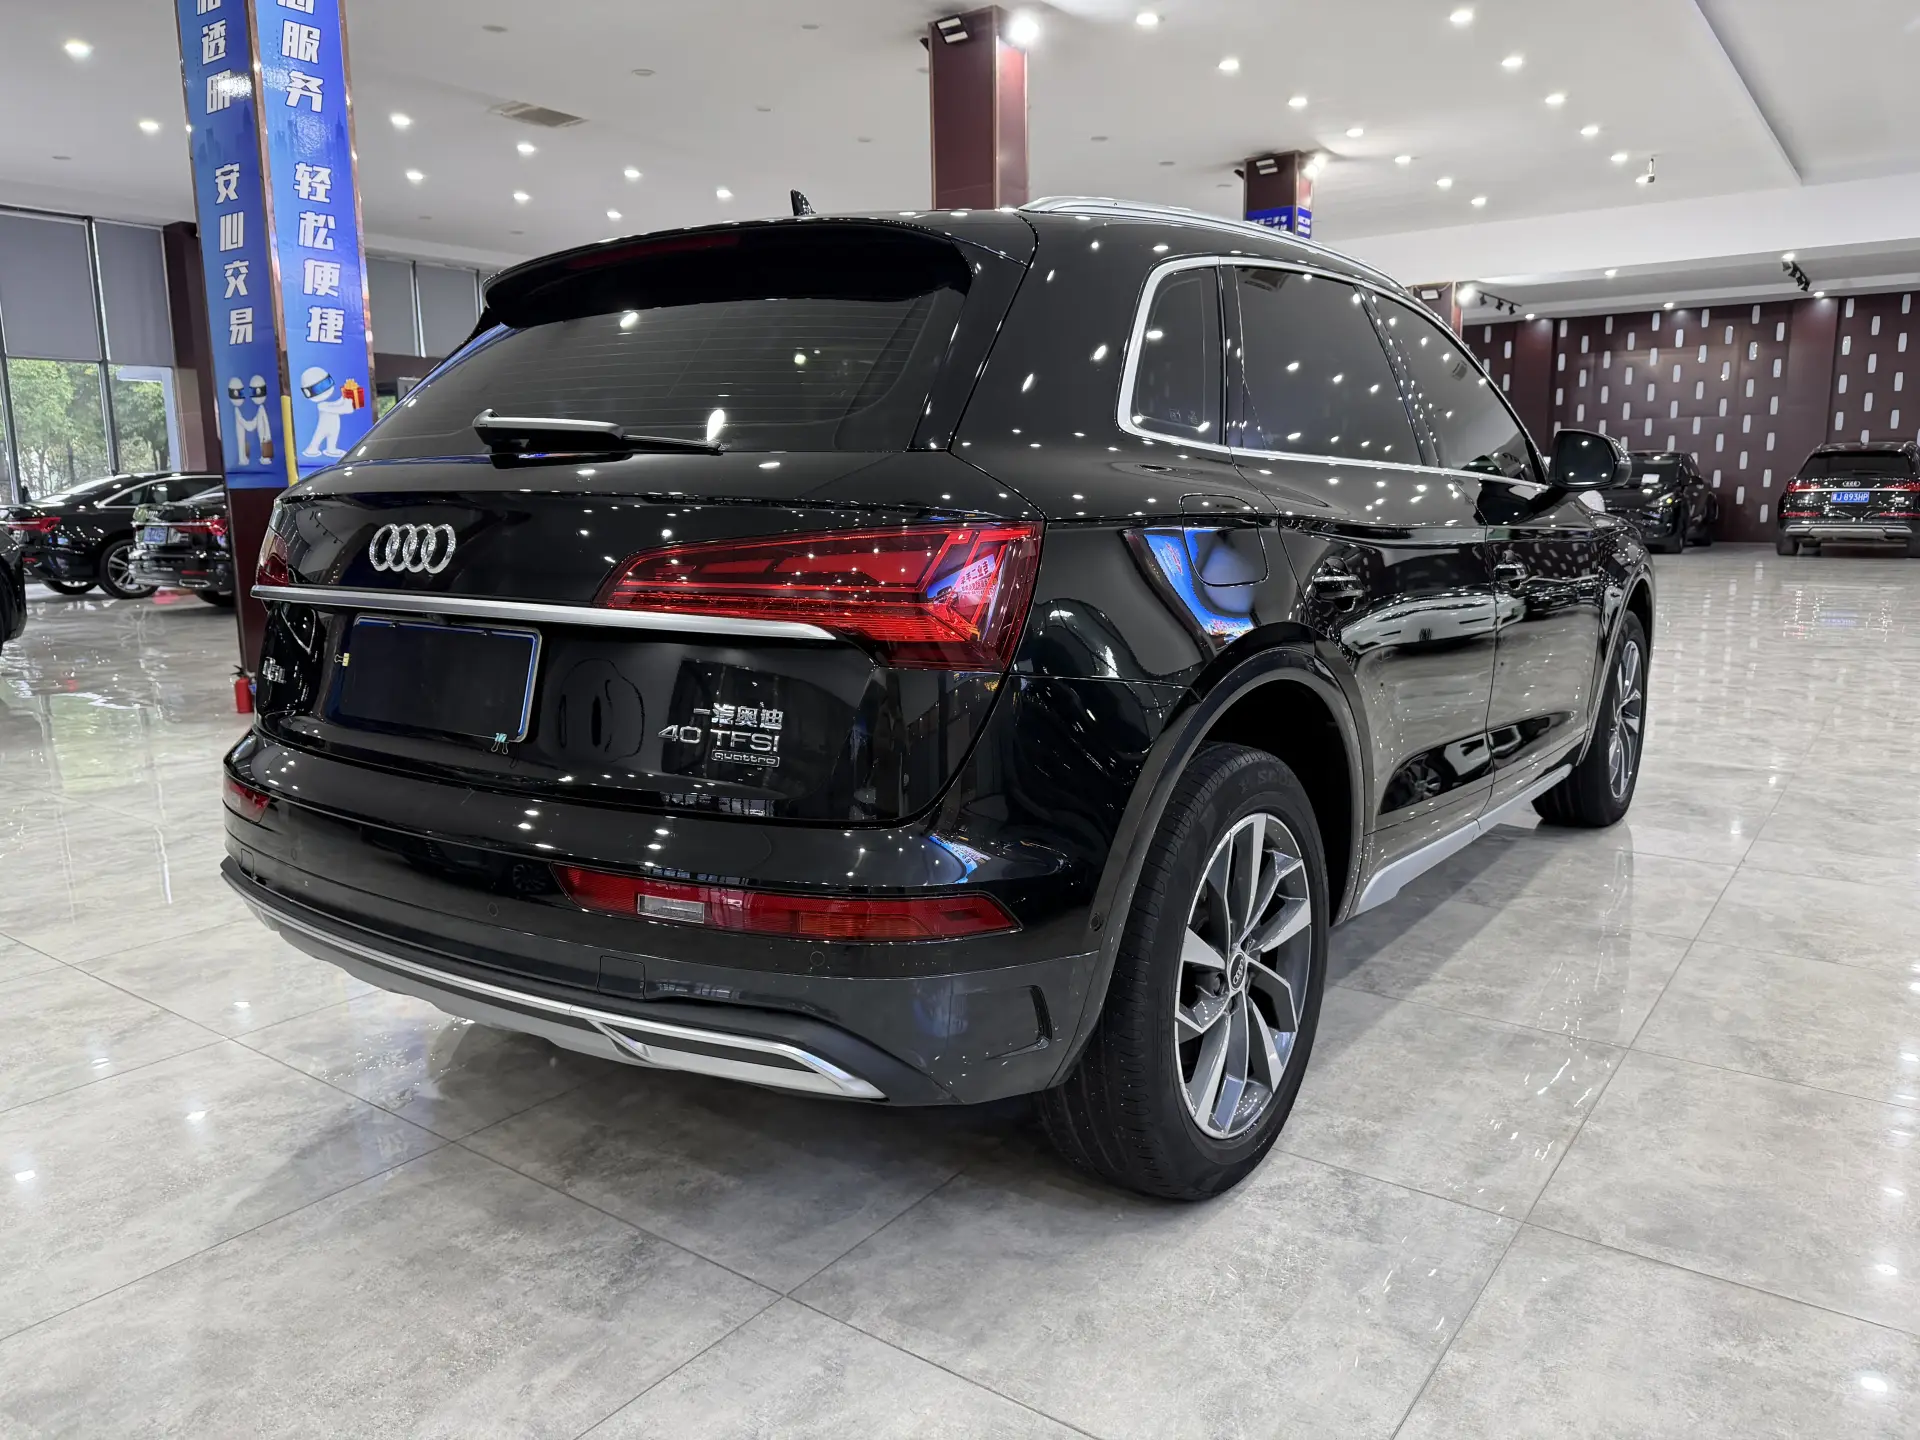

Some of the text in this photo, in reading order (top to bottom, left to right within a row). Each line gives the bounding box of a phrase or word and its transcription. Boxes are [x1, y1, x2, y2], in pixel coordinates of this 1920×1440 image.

[214, 162, 253, 345] 安心交易
[292, 162, 345, 344] 轻松便捷
[693, 702, 783, 729] 一汽奥迪
[658, 725, 780, 752] 40 TFSI
[713, 750, 777, 766] quattro
